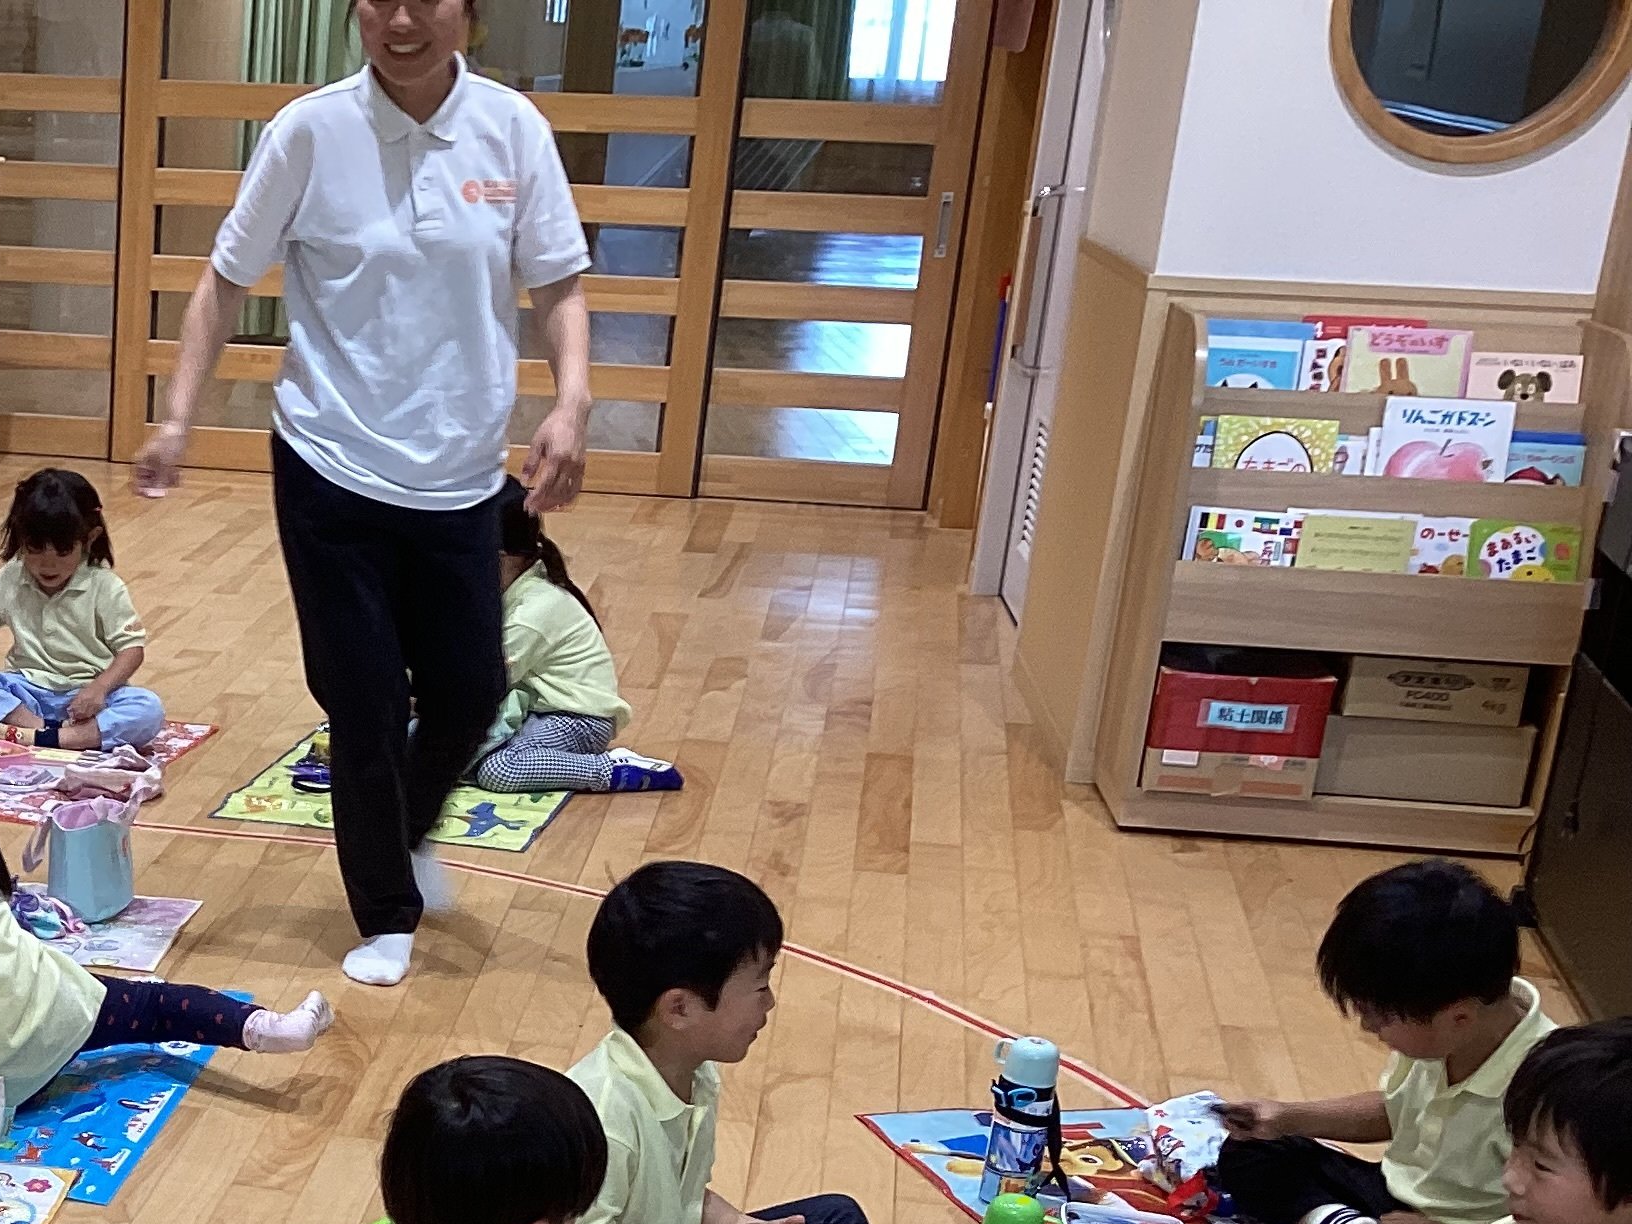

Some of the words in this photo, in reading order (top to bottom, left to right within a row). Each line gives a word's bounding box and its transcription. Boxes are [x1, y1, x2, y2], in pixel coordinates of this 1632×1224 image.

[1496, 547, 1537, 573] たまご
[1218, 706, 1285, 726] 粘土関係
